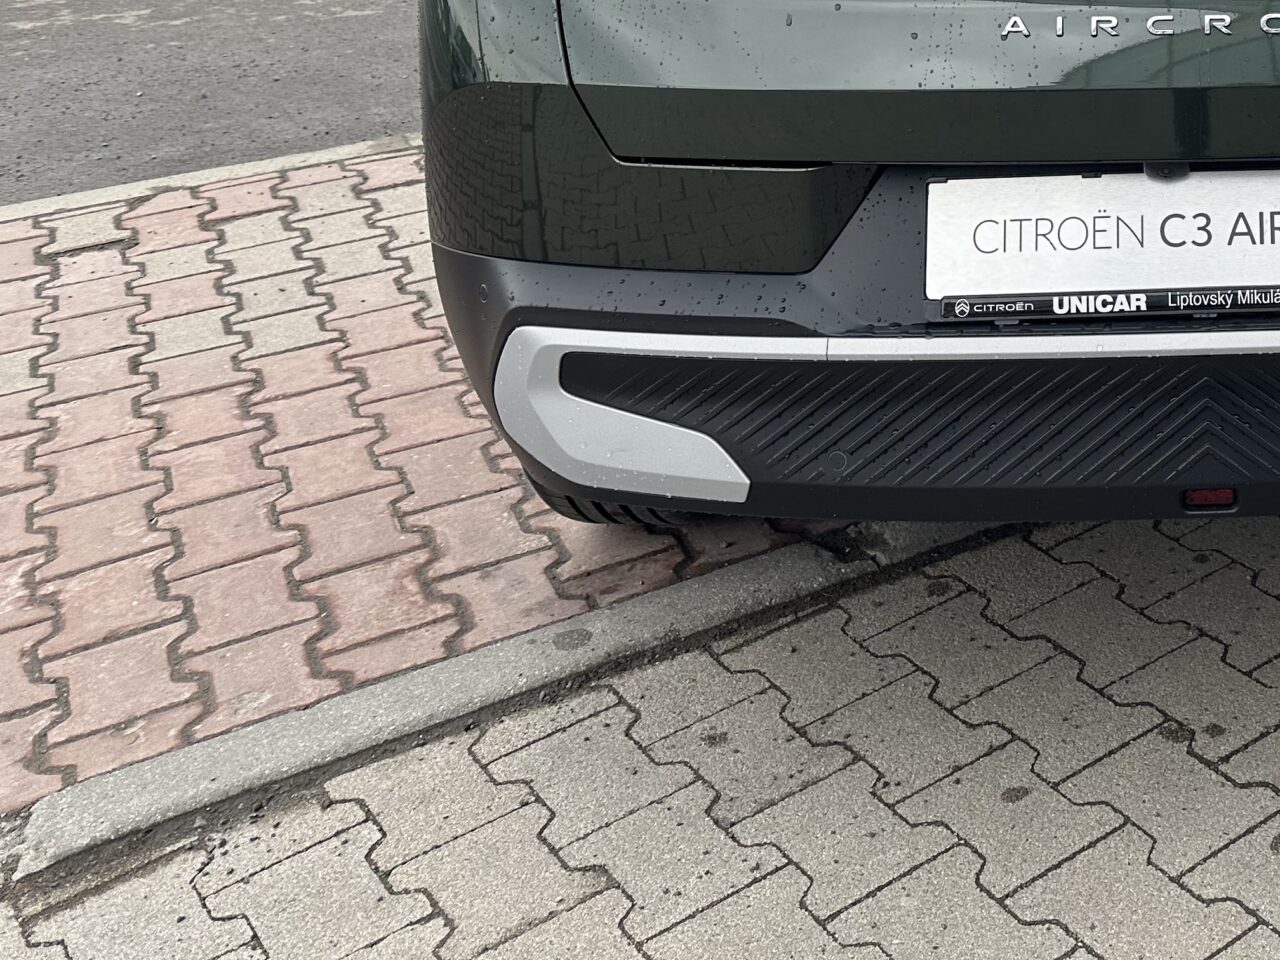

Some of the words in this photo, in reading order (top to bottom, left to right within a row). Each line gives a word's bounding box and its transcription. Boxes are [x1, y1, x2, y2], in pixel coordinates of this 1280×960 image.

[972, 208, 1146, 255] CITROËN
[1158, 212, 1213, 248] C3
[1052, 293, 1148, 315] UNICAR
[1167, 291, 1234, 310] Liptovský
